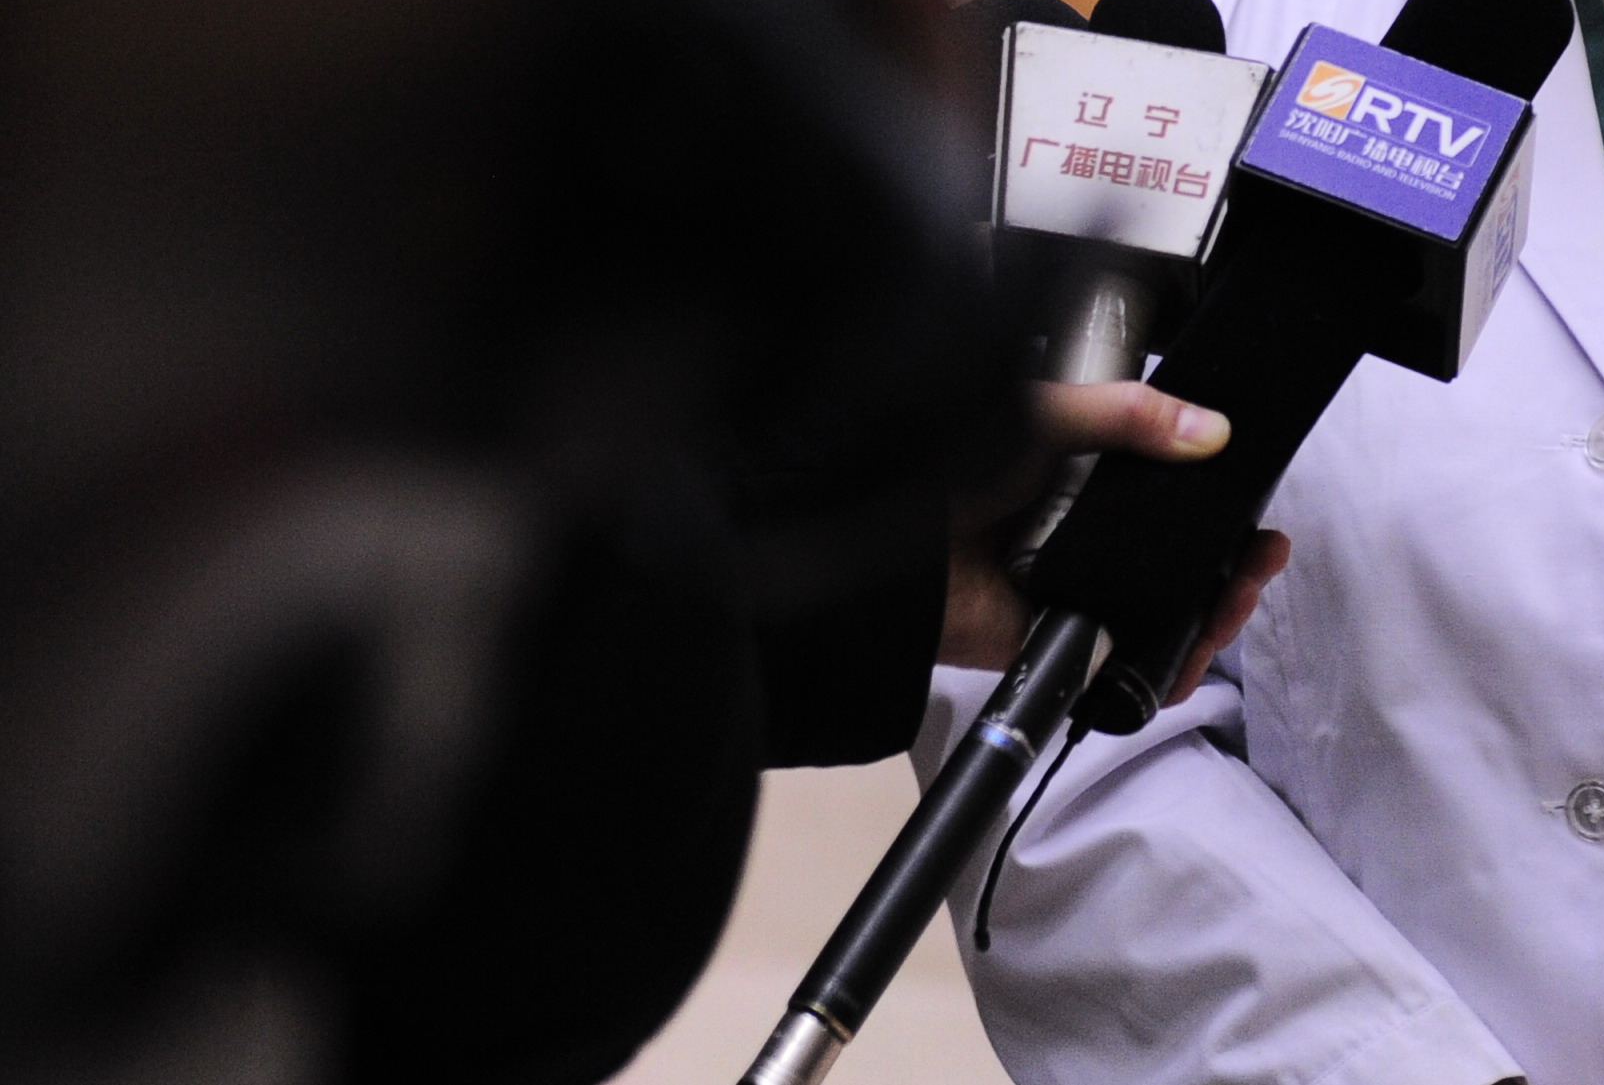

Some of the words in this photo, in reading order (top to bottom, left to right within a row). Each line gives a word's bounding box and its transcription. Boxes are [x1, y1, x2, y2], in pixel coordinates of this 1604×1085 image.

[1074, 92, 1180, 138] 辽宁
[1019, 137, 1211, 199] 广播电视台
[1278, 129, 1336, 156] SHENYANG
[1337, 150, 1373, 169] RADIO
[1372, 161, 1397, 178] AND
[1399, 171, 1458, 201] TELEVISION
[1284, 108, 1465, 190] 沈阳广播电视台
